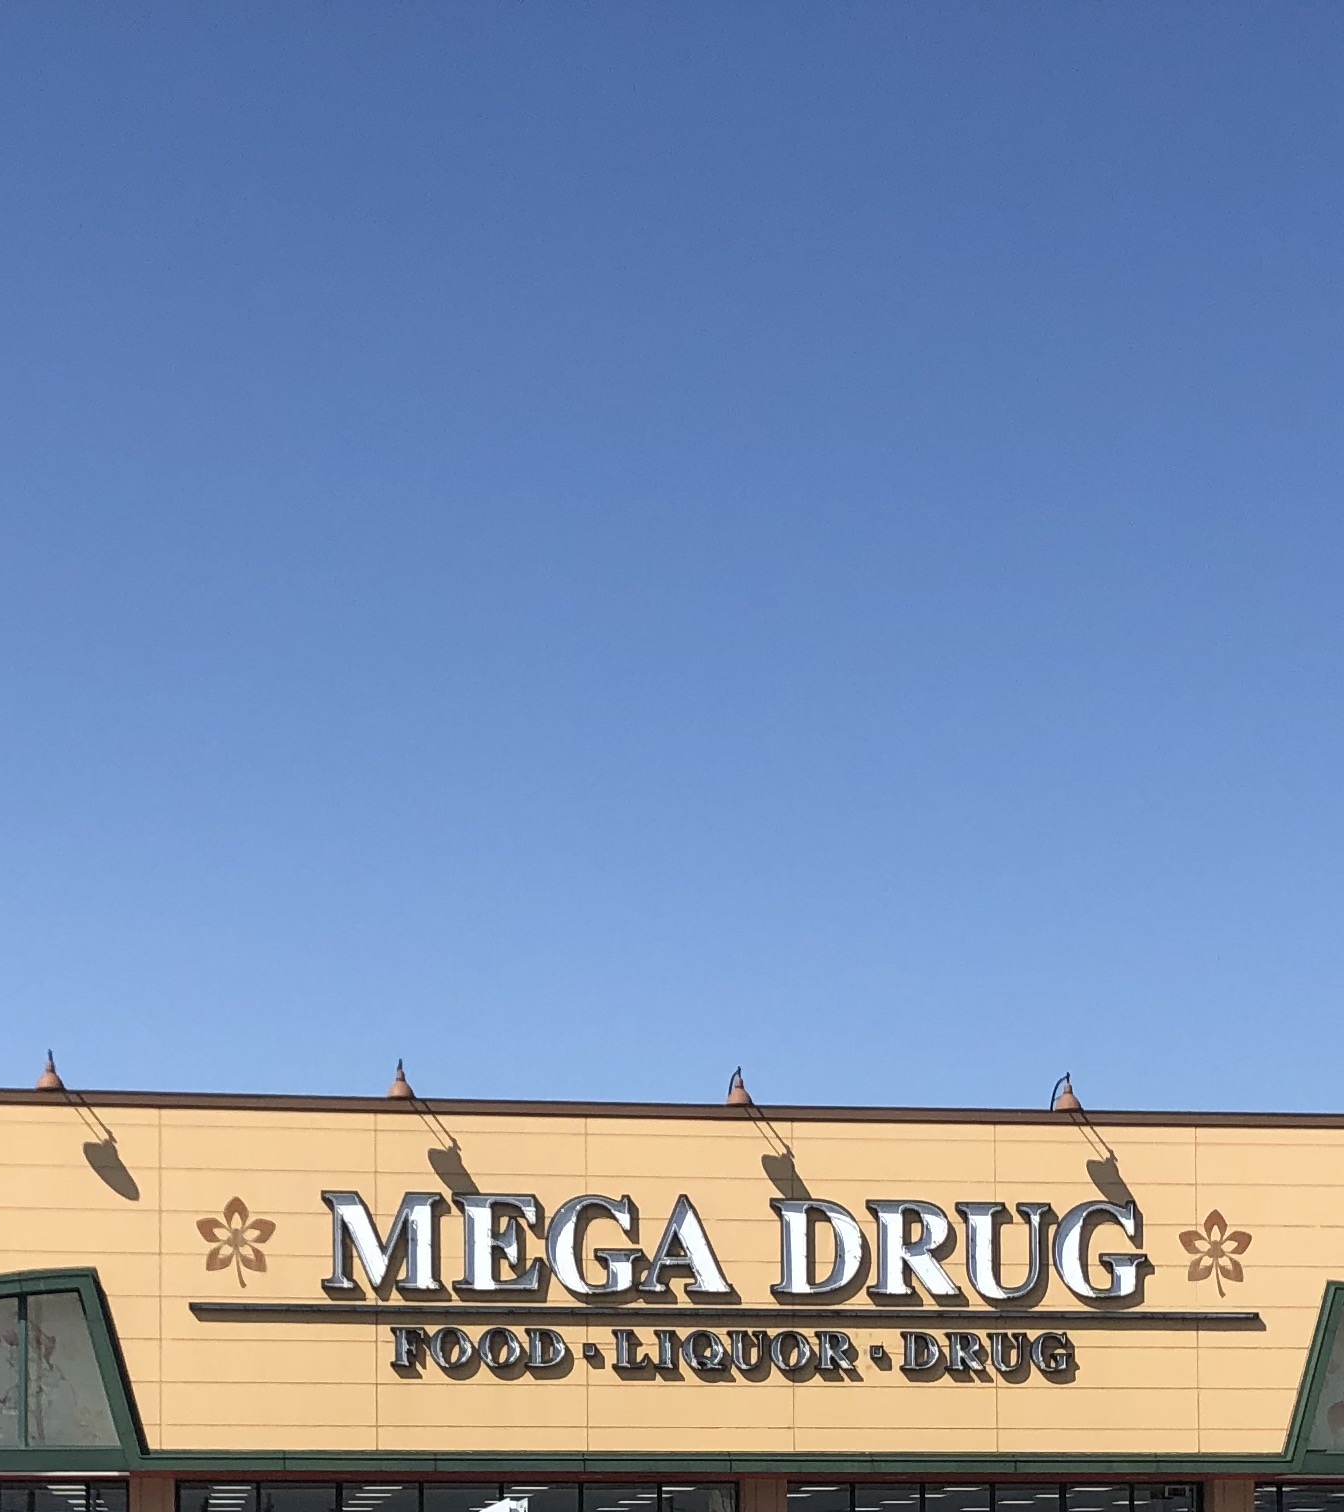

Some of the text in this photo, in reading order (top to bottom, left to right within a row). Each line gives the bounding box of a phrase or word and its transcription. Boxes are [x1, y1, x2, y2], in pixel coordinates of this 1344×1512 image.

[321, 1190, 1149, 1301] MEGA DRUG
[390, 1325, 1073, 1373] FOOD LIQUOR DRUG
